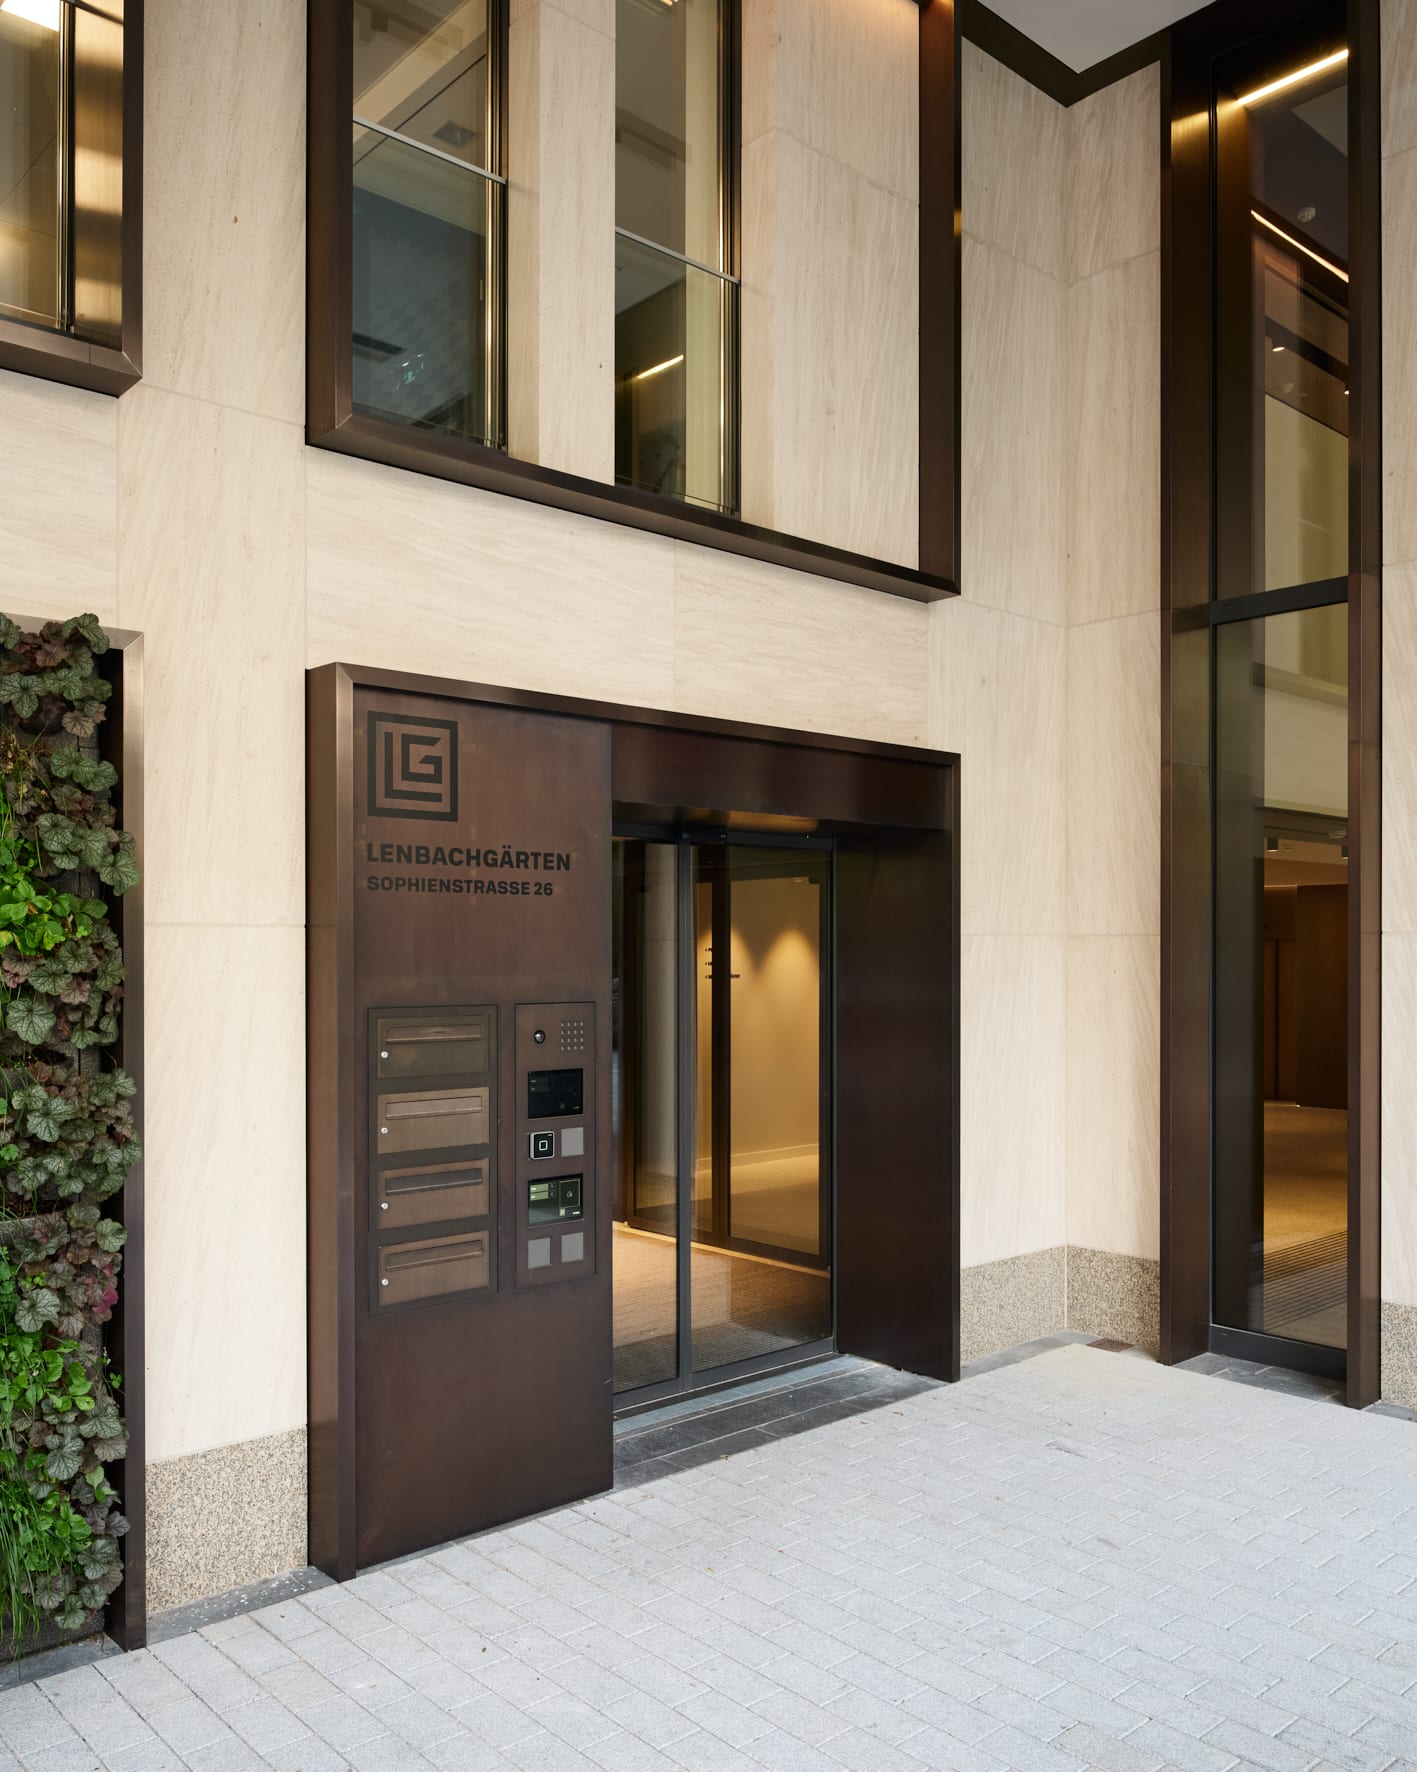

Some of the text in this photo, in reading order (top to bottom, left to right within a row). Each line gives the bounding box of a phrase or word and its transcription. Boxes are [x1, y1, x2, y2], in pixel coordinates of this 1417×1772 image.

[367, 843, 570, 871] LENBACHGÄRTEN
[367, 876, 553, 896] SOPHIENSTRASSE 26
